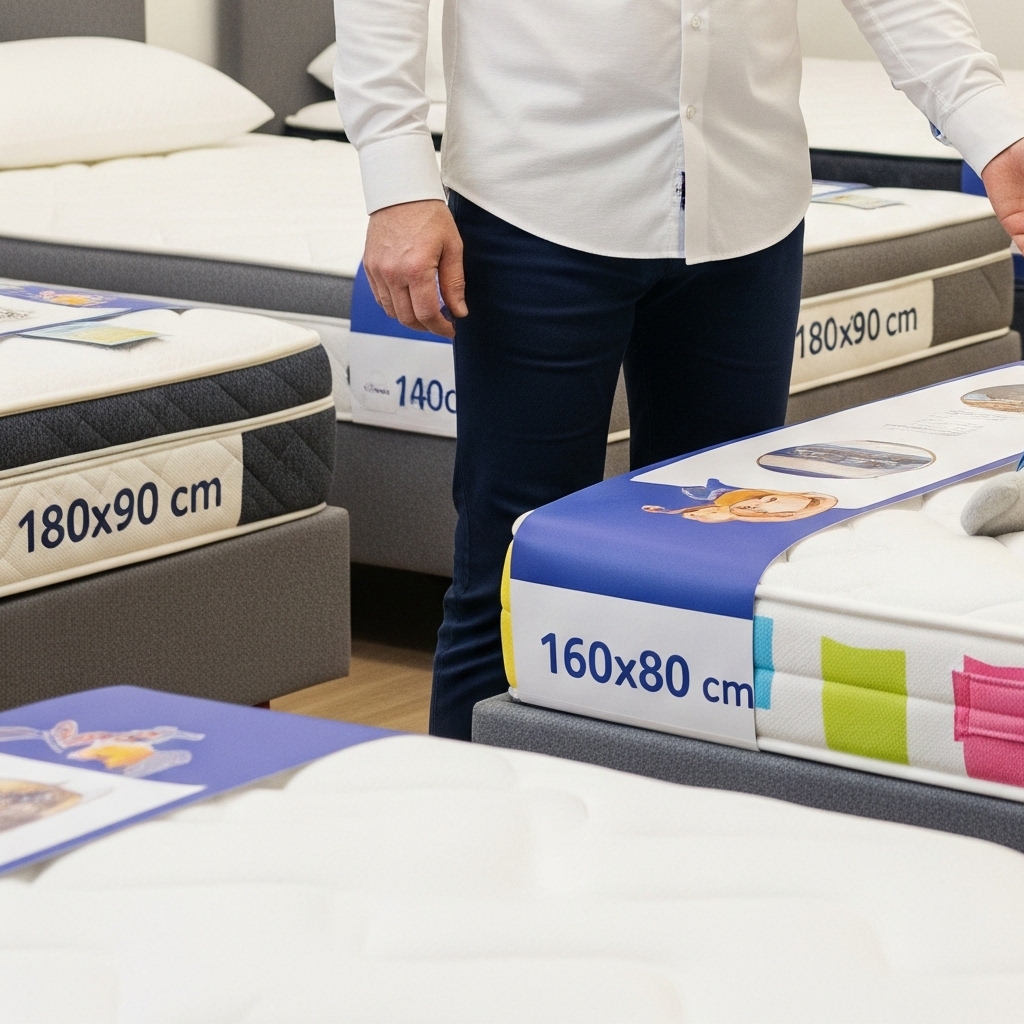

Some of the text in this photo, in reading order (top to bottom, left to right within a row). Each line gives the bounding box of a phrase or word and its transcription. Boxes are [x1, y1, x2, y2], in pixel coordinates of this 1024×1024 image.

[795, 307, 918, 359] 180x90 cm
[18, 477, 222, 553] 180x90 cm
[540, 632, 754, 709] 160x80 cm
